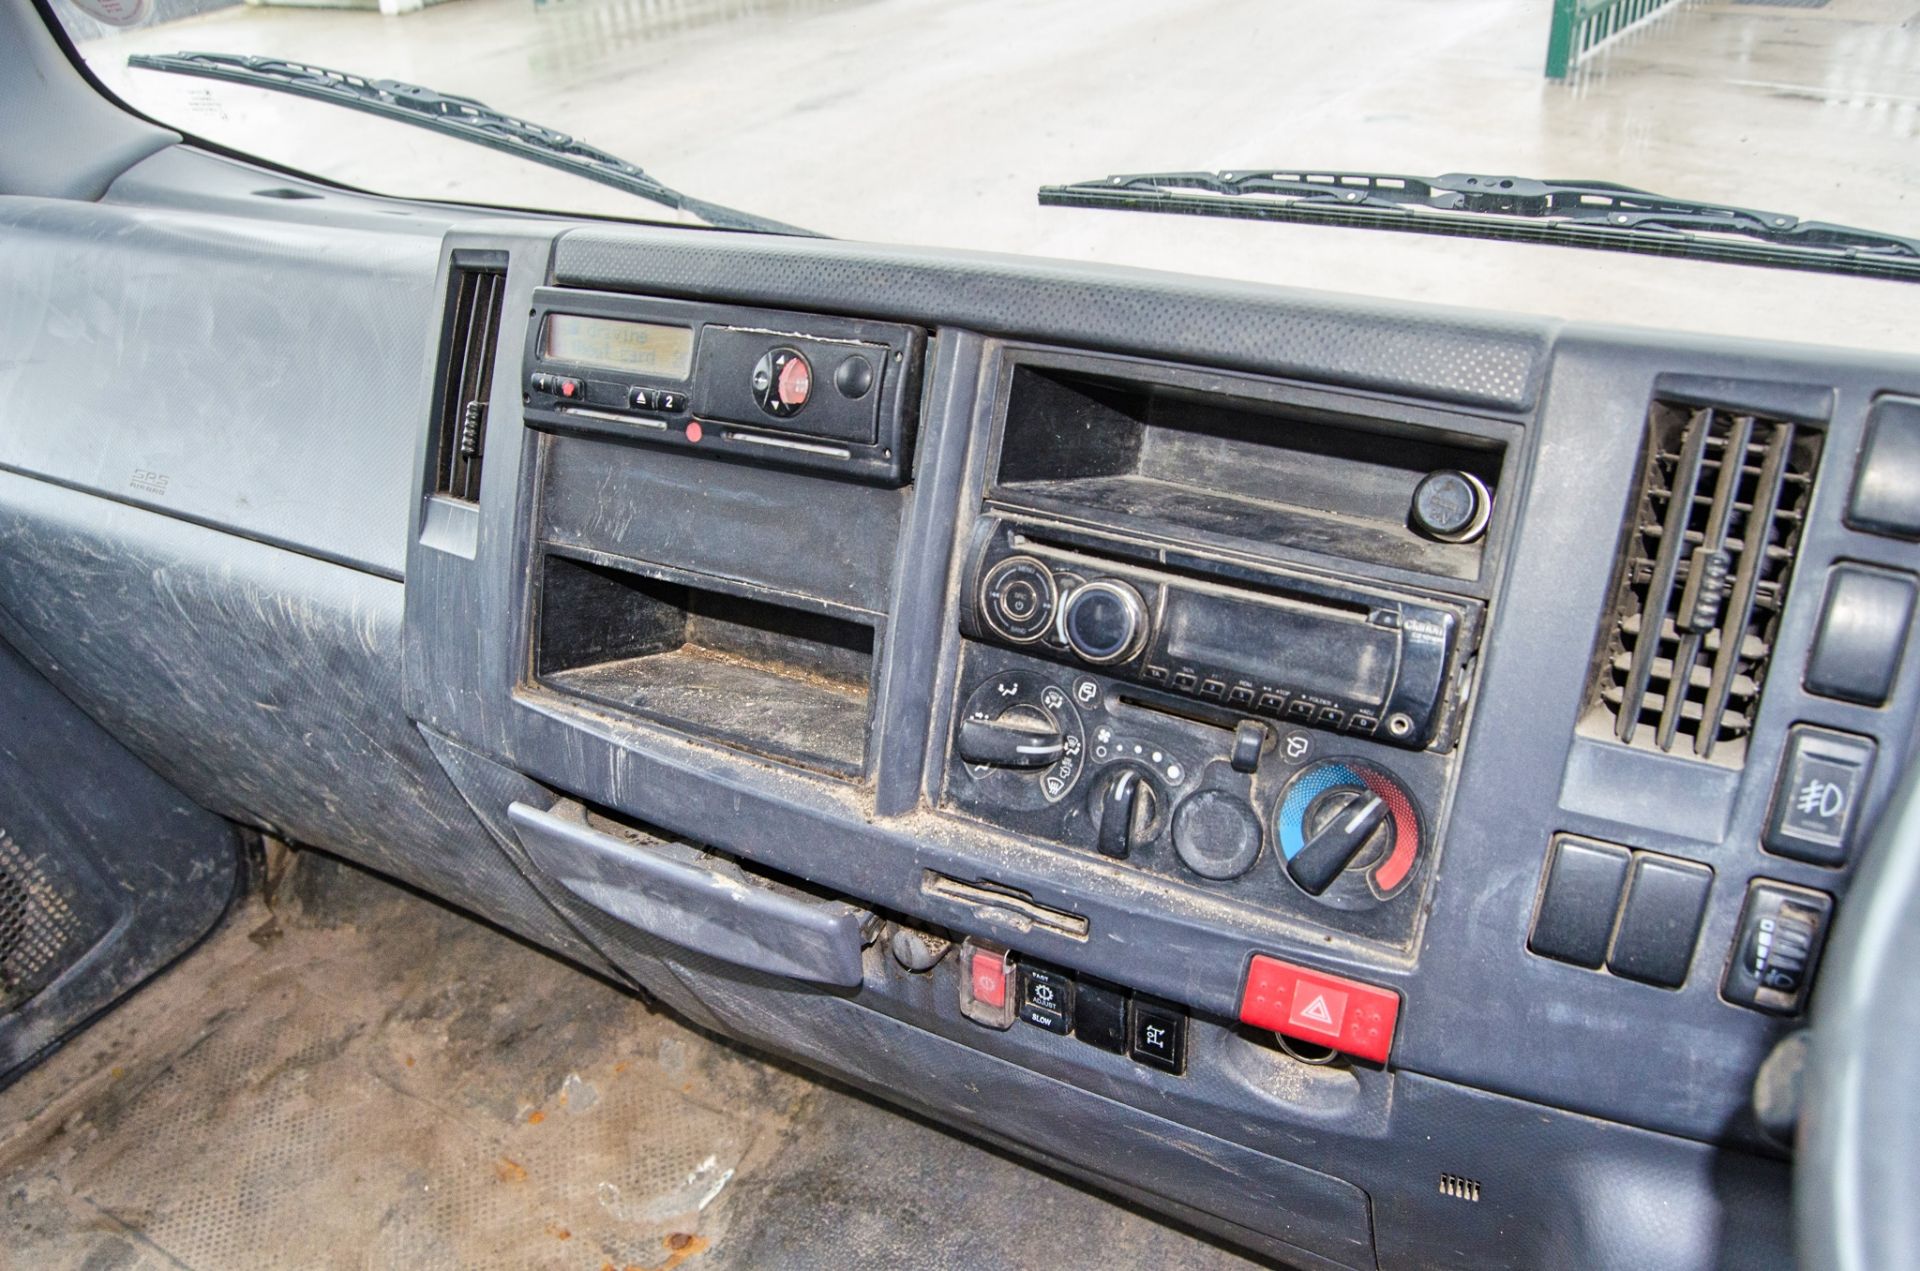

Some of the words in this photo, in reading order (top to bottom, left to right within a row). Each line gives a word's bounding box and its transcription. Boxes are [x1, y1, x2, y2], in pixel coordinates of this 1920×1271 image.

[539, 377, 545, 389] 1
[665, 396, 673, 408] 2
[131, 468, 170, 486] SRS
[1018, 565, 1036, 575] MENU
[1032, 972, 1049, 982] FAST
[1032, 997, 1056, 1009] ADJUST
[1032, 1013, 1052, 1026] SLOW
